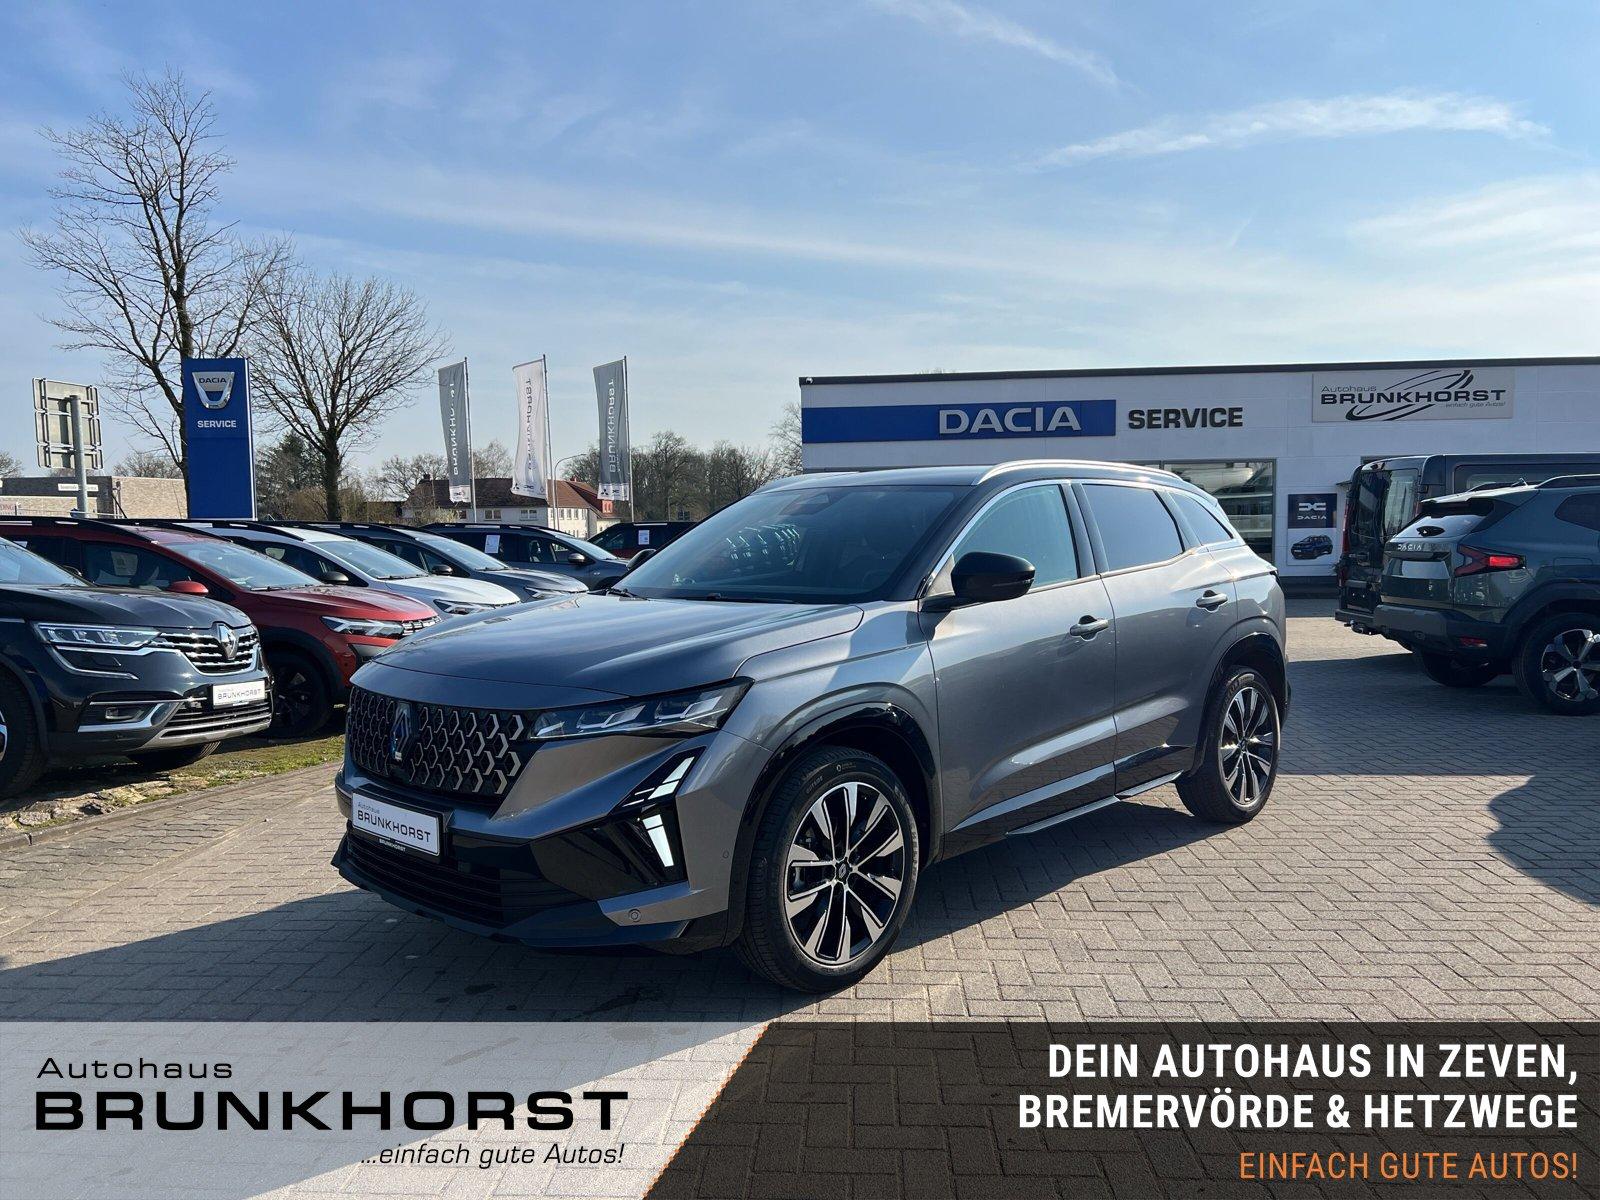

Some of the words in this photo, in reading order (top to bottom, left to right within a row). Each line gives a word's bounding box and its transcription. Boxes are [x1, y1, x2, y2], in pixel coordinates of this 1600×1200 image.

[1321, 385, 1377, 393] Autohaus
[1320, 389, 1506, 405] BRUNKHORST
[197, 420, 237, 428] SERVICE
[939, 406, 1082, 434] DACIA
[1128, 407, 1244, 430] SERVICE
[1398, 543, 1422, 551] DACIA
[217, 688, 262, 700] BRUNKHORST
[357, 810, 431, 842] BRUNKHORST
